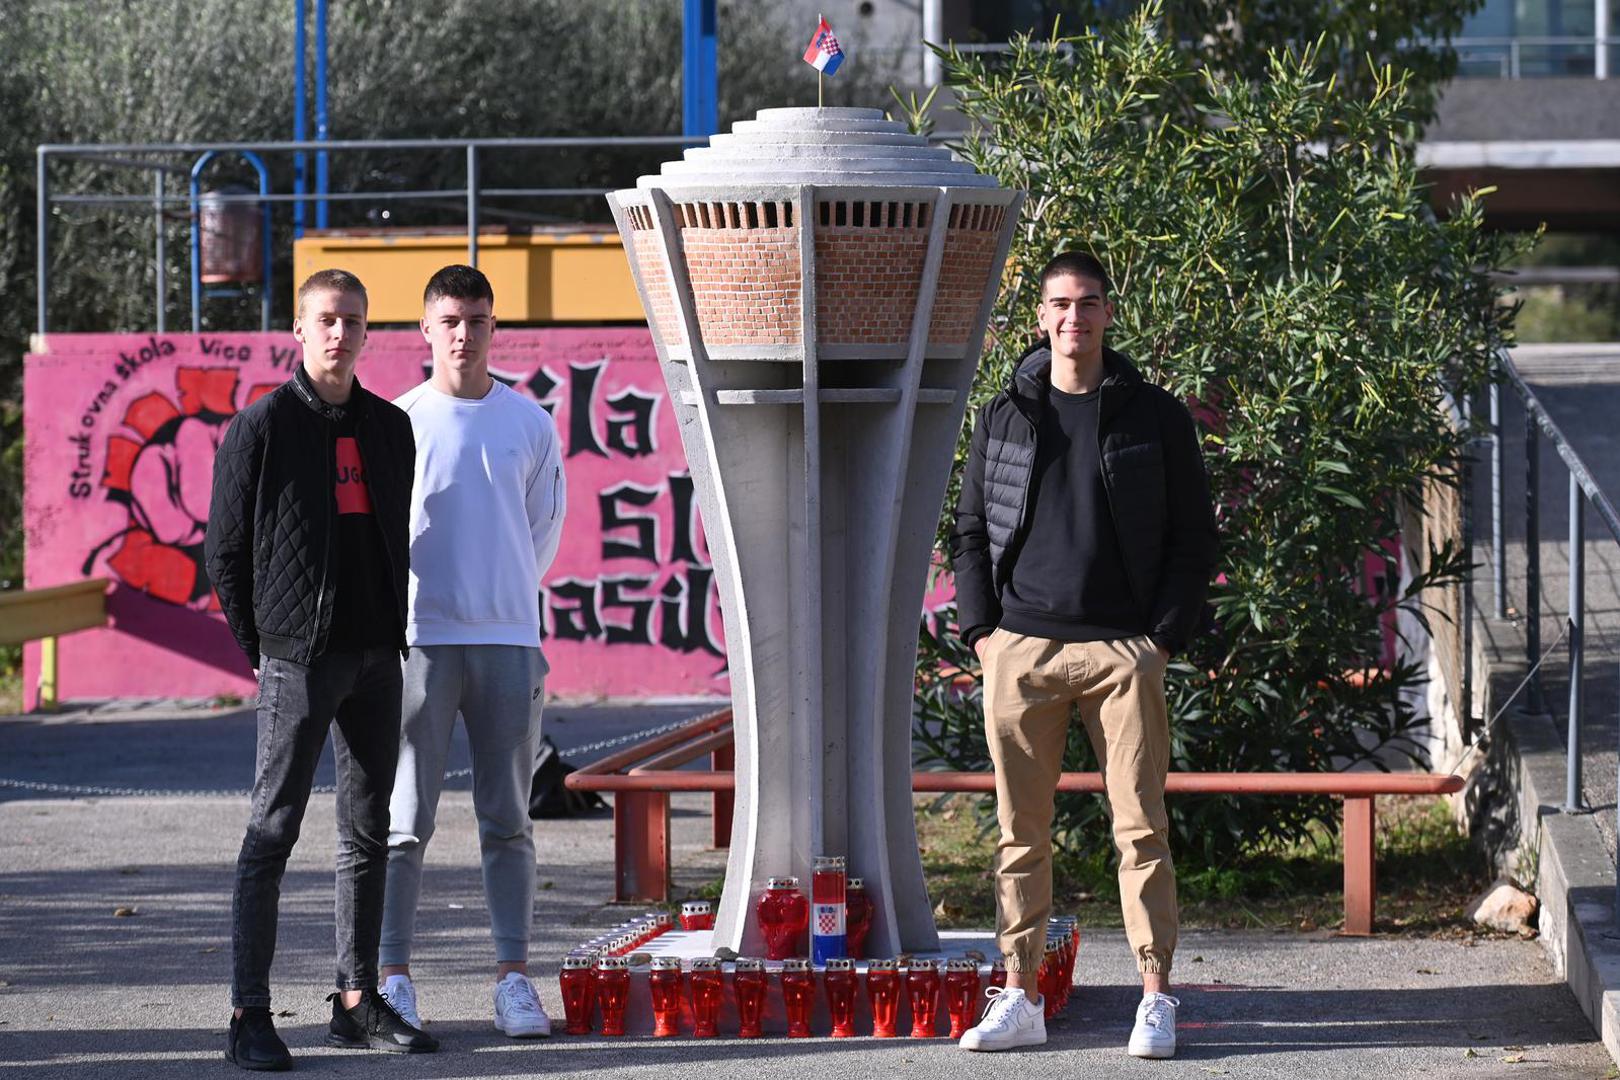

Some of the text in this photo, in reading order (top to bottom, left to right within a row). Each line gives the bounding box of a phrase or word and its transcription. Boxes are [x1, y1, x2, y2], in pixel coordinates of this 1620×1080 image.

[199, 338, 252, 362] Vice
[269, 344, 299, 373] Vl
[598, 472, 712, 565] sl
